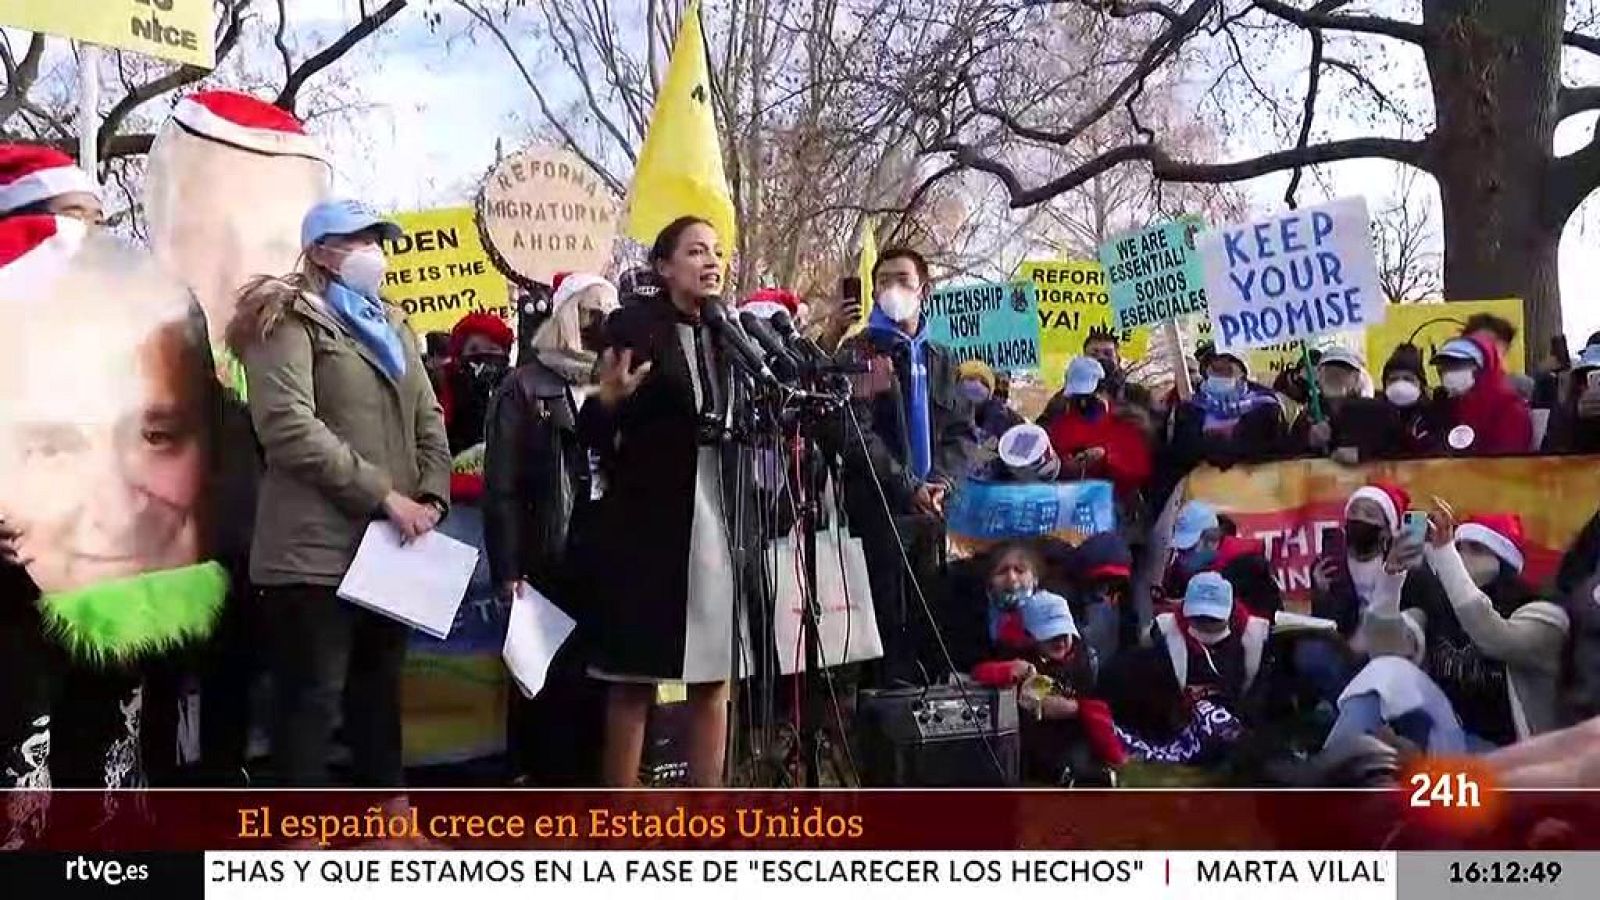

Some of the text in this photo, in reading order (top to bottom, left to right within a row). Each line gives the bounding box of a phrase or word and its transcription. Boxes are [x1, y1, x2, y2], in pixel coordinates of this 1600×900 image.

[497, 160, 598, 198] REFORMA
[513, 229, 594, 251] AHORA
[1116, 228, 1168, 261] WE ARE
[1223, 211, 1334, 268] KEEP
[418, 265, 441, 282] IS
[446, 260, 486, 278] THE
[1135, 271, 1187, 302] SOMOS
[1229, 252, 1343, 303] YOUR
[921, 286, 1003, 318] CITIZENSHIP
[1120, 288, 1208, 328] ESENCIALES
[1218, 287, 1363, 347] PROMISE
[949, 314, 980, 339] NOW
[1038, 310, 1080, 331] YA!
[998, 337, 1036, 366] AHORA
